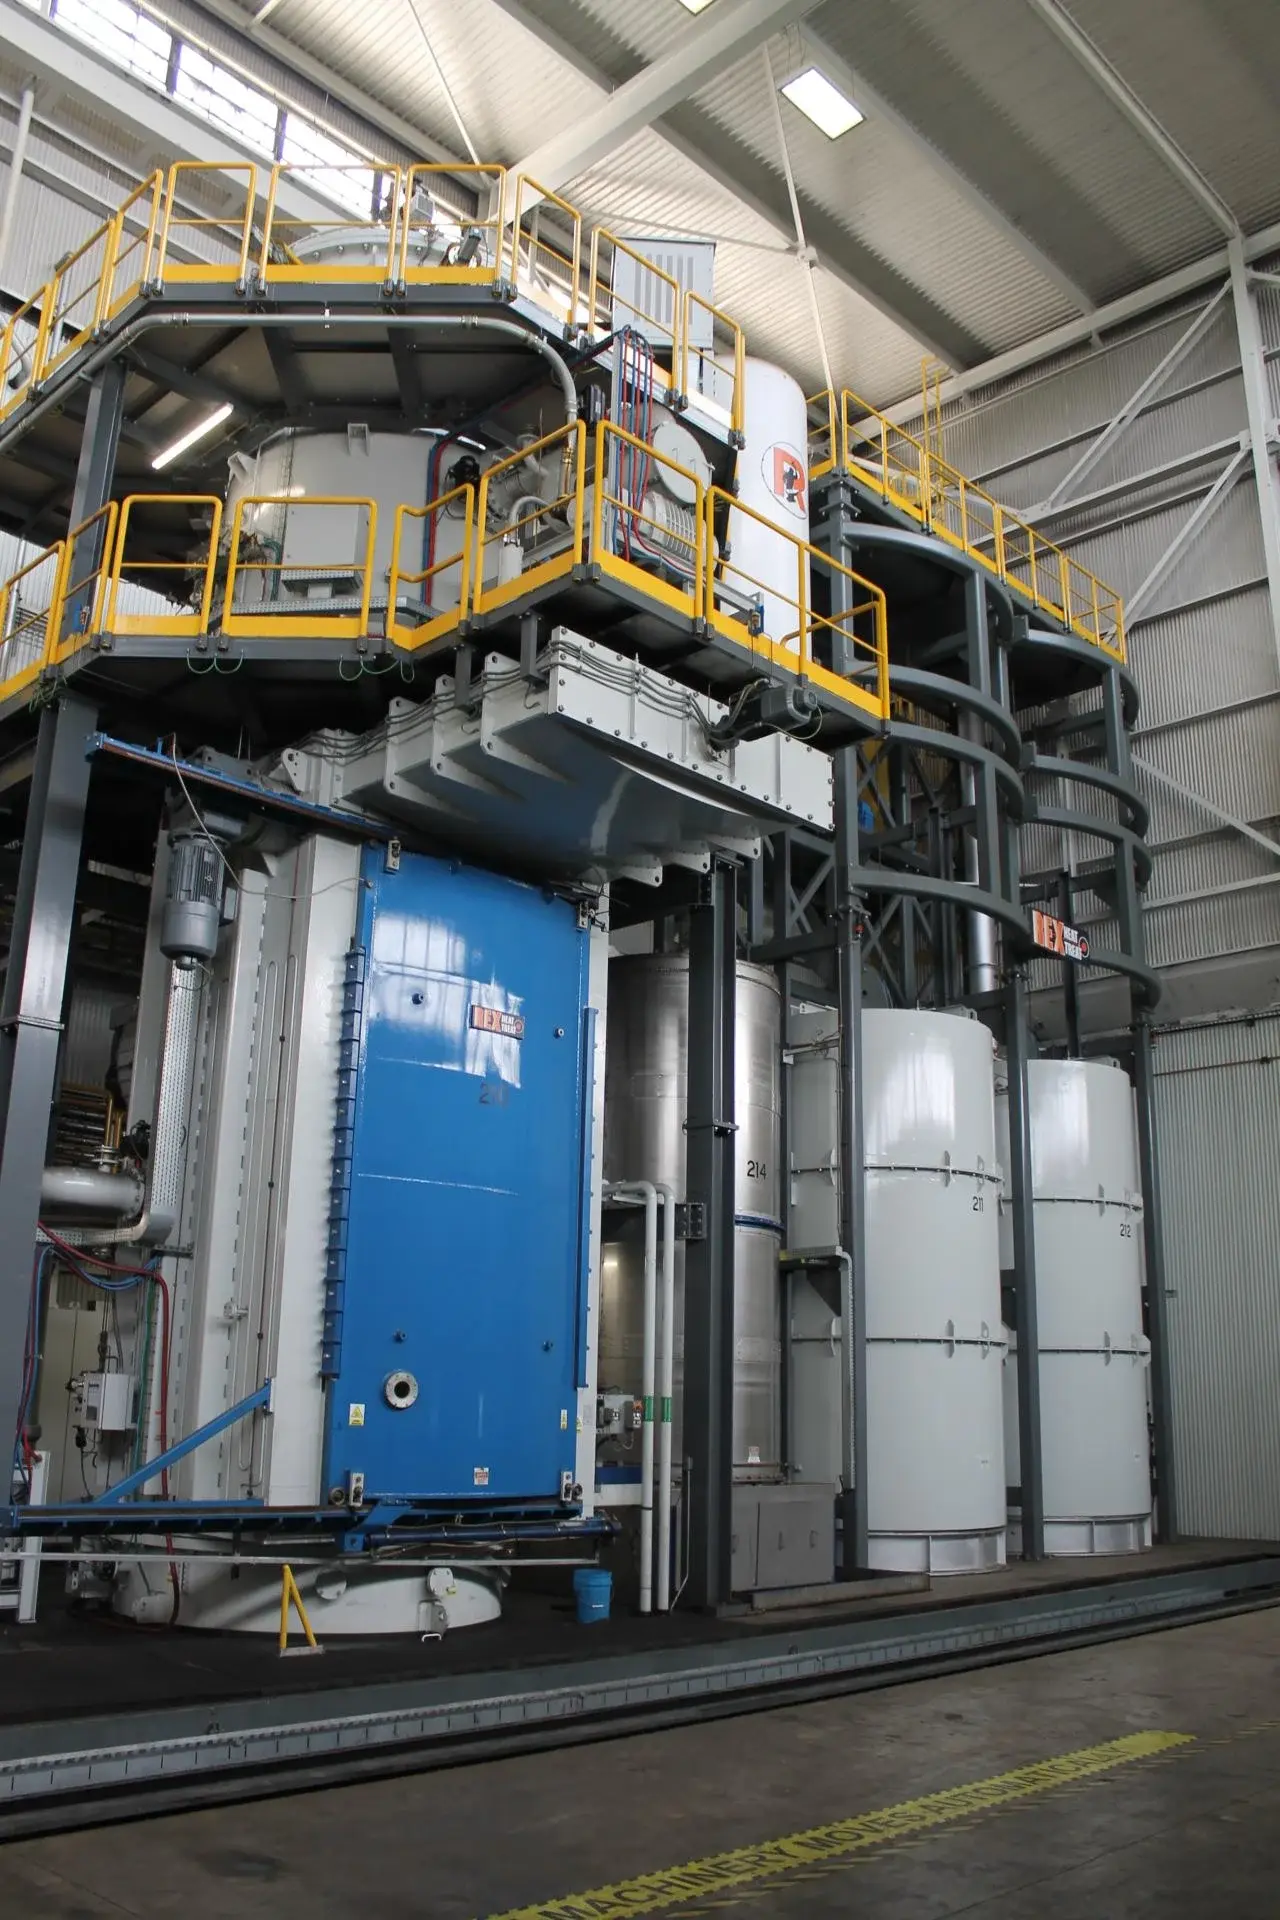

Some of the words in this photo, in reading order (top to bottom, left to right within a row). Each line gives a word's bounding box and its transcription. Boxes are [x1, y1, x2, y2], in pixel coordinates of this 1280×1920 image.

[1033, 910, 1065, 956] REX
[1064, 926, 1079, 944] HEAT
[1064, 941, 1082, 960] TREAT
[474, 1007, 502, 1032] REX
[746, 1160, 767, 1180] 214
[973, 1196, 984, 1212] 211
[1120, 1223, 1131, 1238] 212
[538, 1847, 797, 1920] MACHINERY
[793, 1811, 927, 1850] MOVES
[921, 1746, 1130, 1812] AUTOMATICALLY
